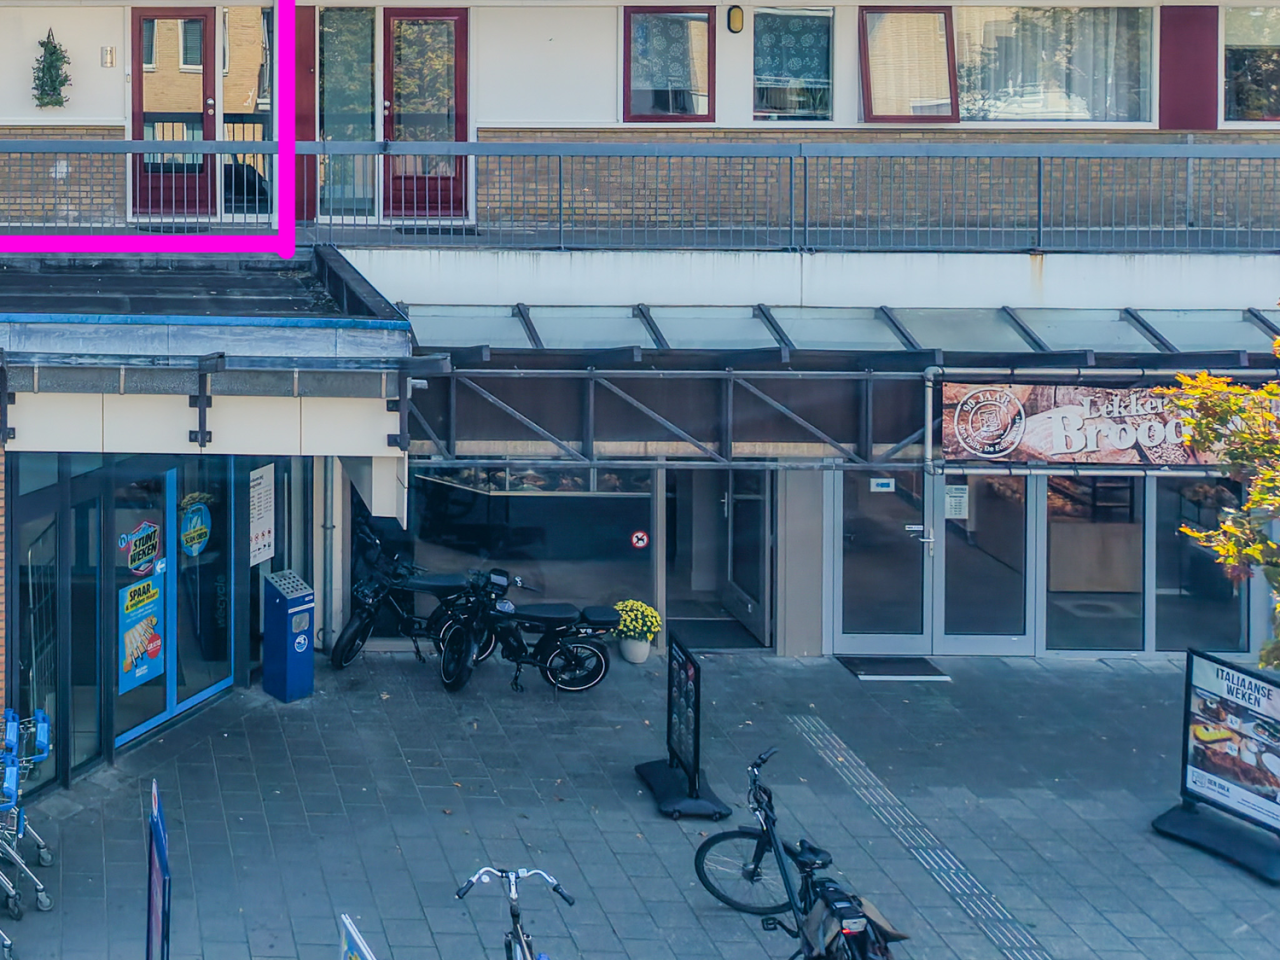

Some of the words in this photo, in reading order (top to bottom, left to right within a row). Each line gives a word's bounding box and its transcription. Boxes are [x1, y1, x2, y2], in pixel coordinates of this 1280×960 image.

[963, 398, 976, 413] 90
[978, 392, 1011, 407] JAAR
[1079, 393, 1169, 419] Lekker
[130, 540, 158, 565] WEKEN
[132, 528, 158, 552] STUNT
[129, 583, 151, 602] SPAAR
[1216, 667, 1274, 701] ITALIAANSE
[1226, 683, 1261, 708] WEKEN
